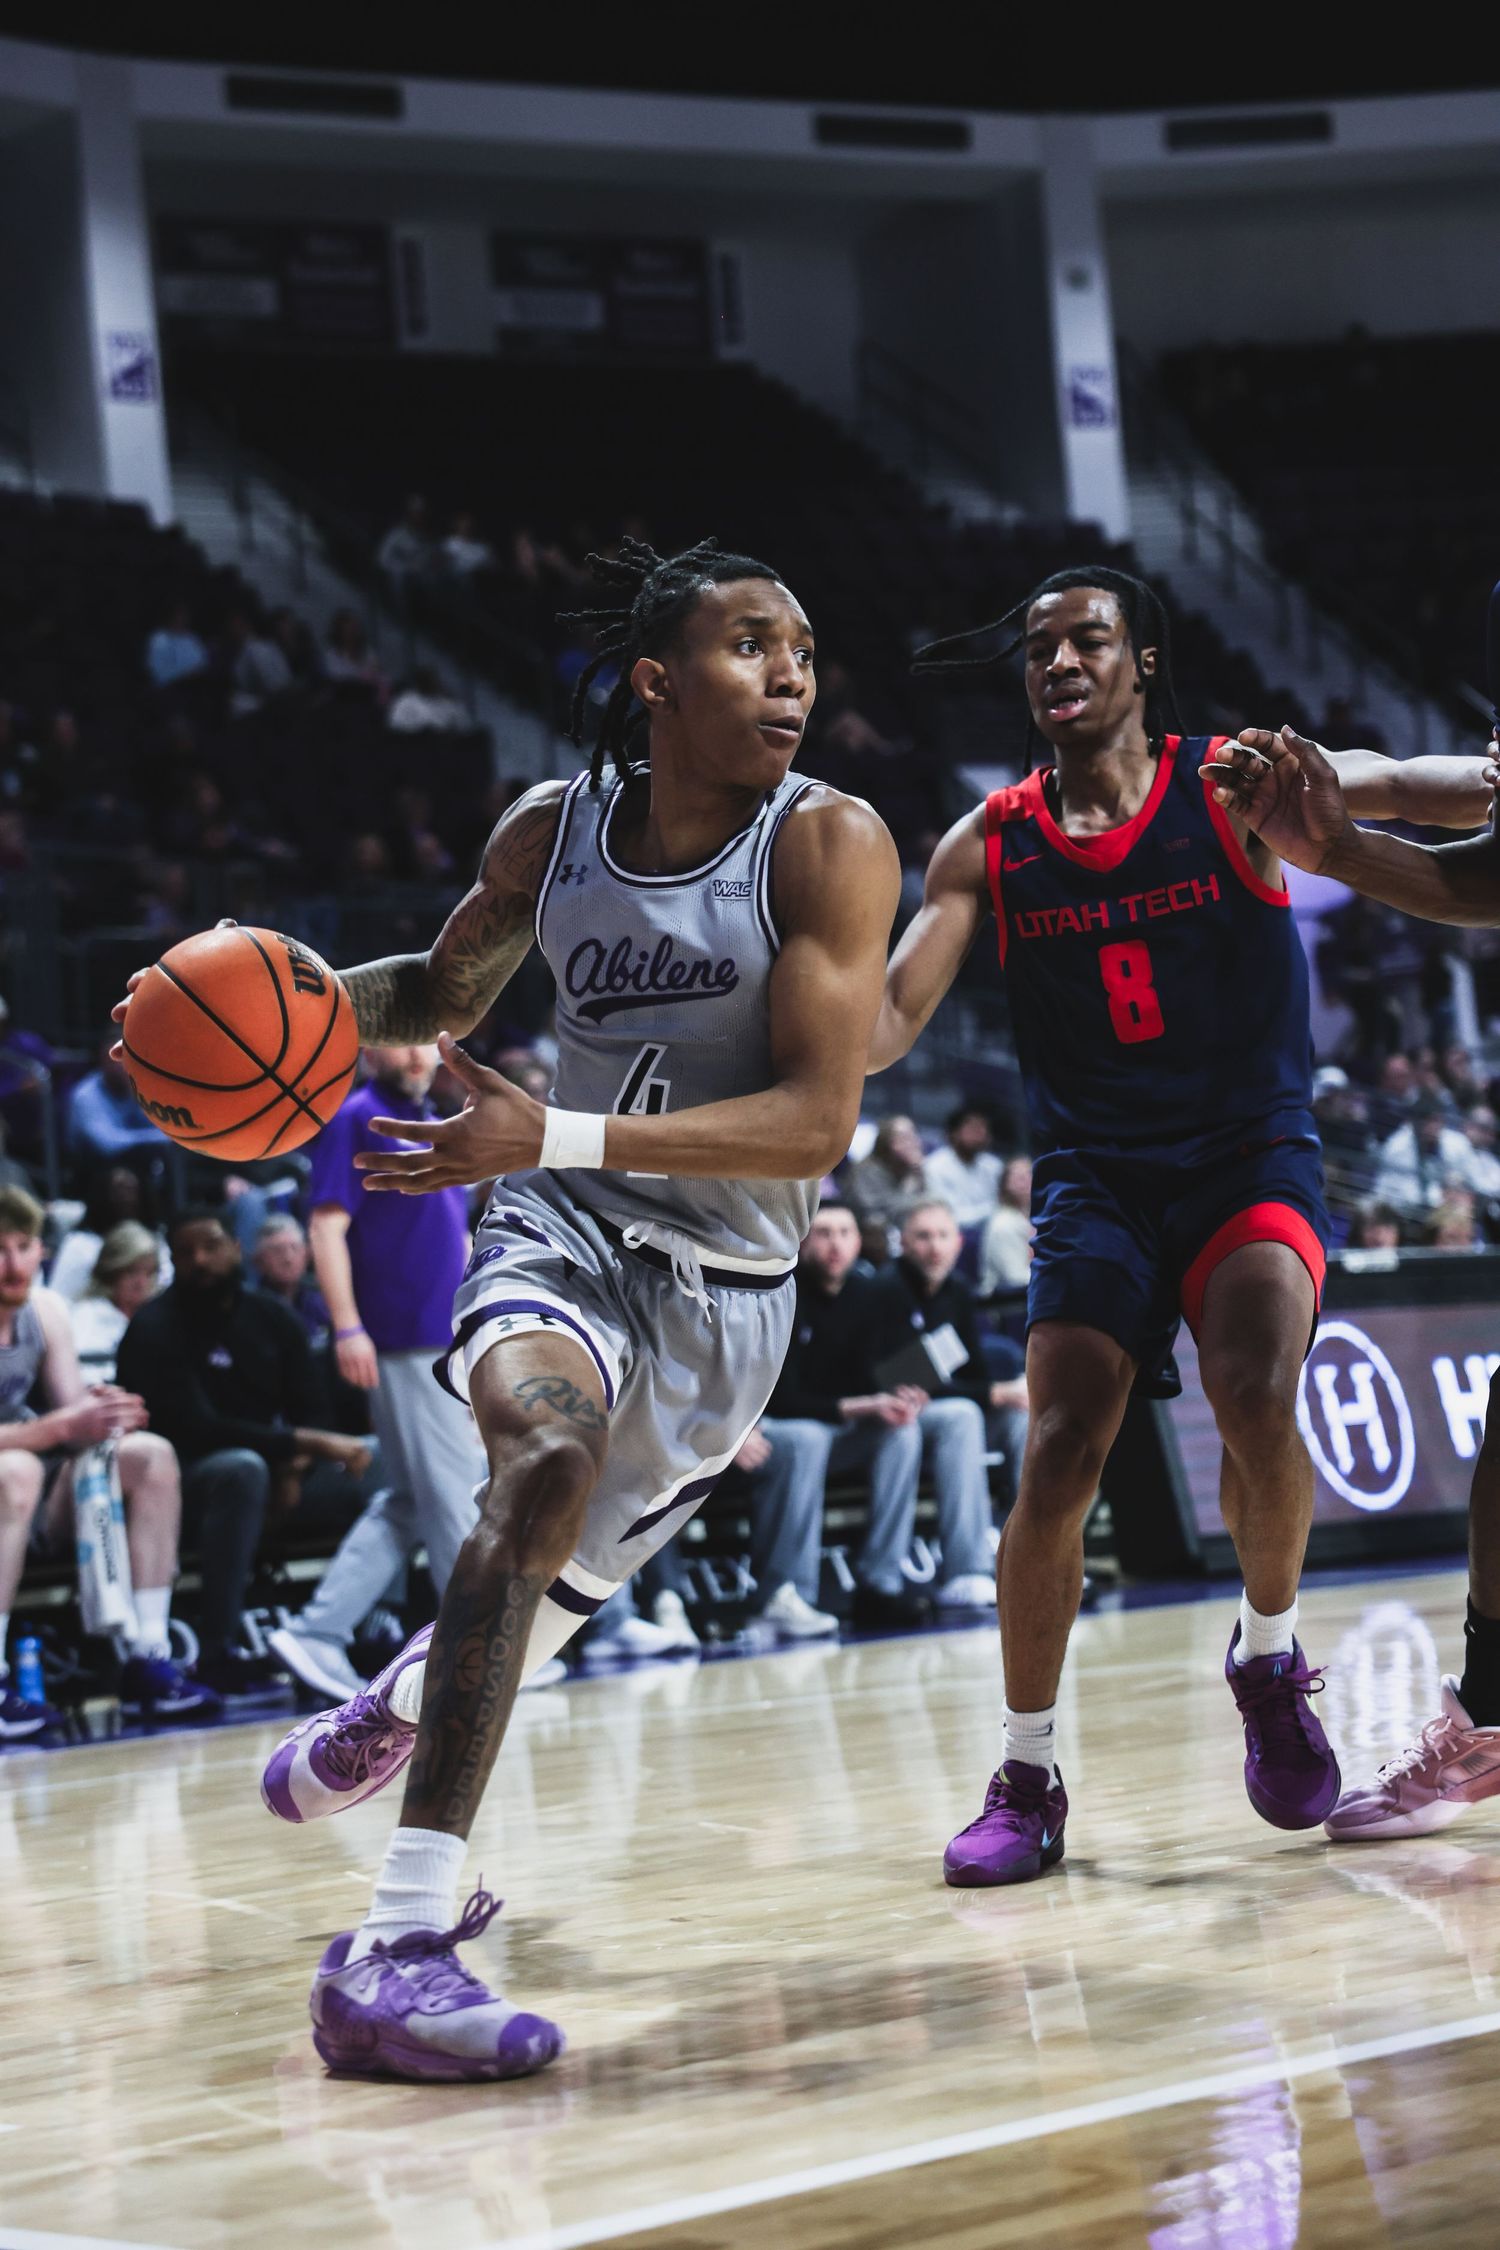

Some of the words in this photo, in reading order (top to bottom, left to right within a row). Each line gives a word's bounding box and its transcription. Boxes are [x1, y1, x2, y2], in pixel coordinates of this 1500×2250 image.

[713, 880, 753, 897] WAC
[1014, 901, 1110, 938] UTAH
[1119, 873, 1221, 922] TECH
[565, 933, 740, 999] Abilene
[1098, 938, 1165, 1044] 8
